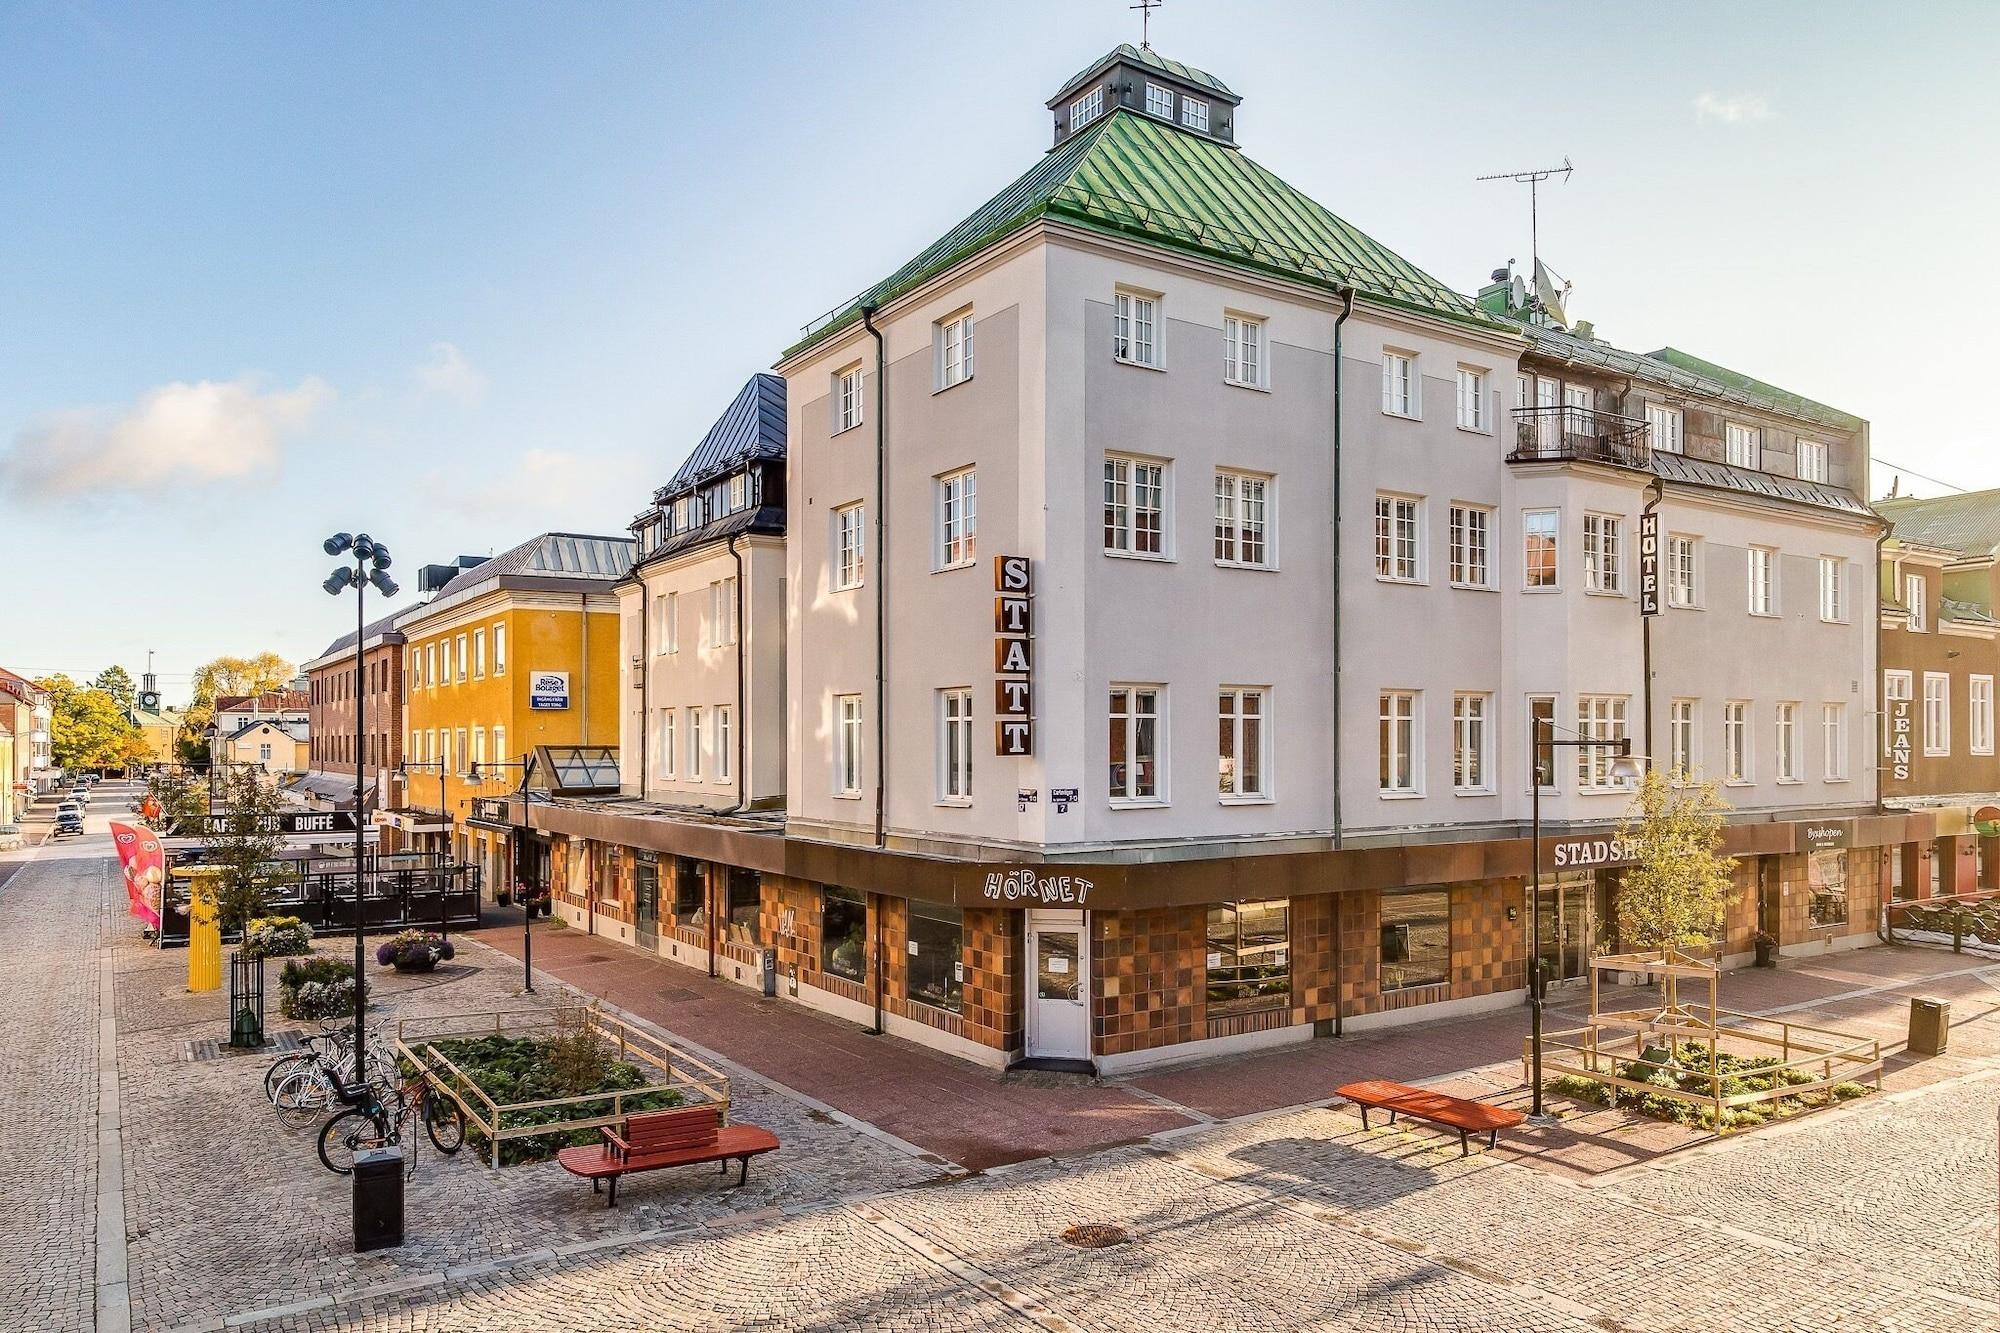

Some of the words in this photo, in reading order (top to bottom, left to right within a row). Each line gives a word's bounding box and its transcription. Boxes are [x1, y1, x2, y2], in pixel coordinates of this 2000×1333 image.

[1642, 517, 1657, 612] HOTEL
[1003, 558, 1030, 753] STATT
[1892, 702, 1912, 780] JEANS
[295, 814, 334, 831] BUFFÉ
[983, 869, 1095, 905] HÖRNET
